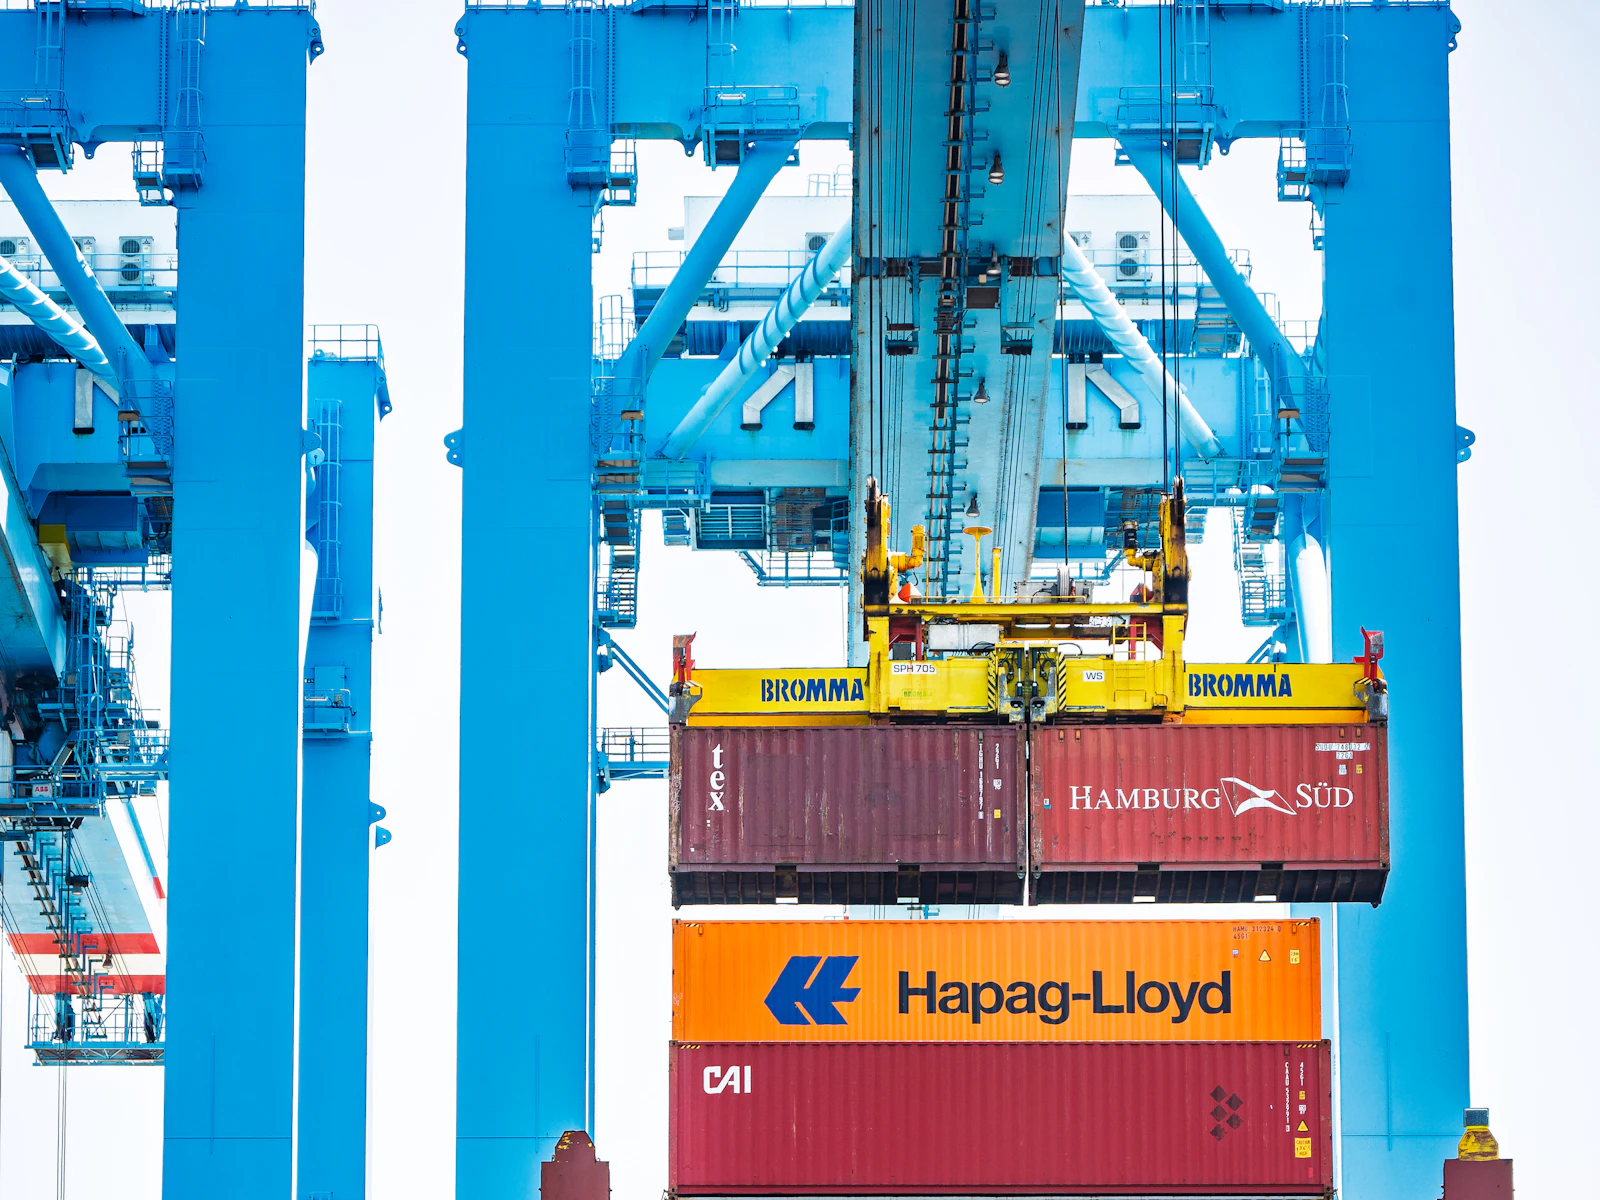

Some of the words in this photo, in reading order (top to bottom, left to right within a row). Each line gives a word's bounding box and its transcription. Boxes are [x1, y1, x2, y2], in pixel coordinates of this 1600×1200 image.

[893, 664, 914, 673] SPH
[916, 664, 936, 673] 705
[1085, 671, 1103, 681] WS
[761, 679, 865, 702] BROMMA
[1188, 673, 1292, 698] BROMMA
[708, 744, 727, 811] tex
[1069, 785, 1221, 810] HAMBURG
[1296, 782, 1354, 809] SÜD
[898, 970, 1231, 1024] Hapag-Lloyd
[703, 1065, 752, 1094] CAI
